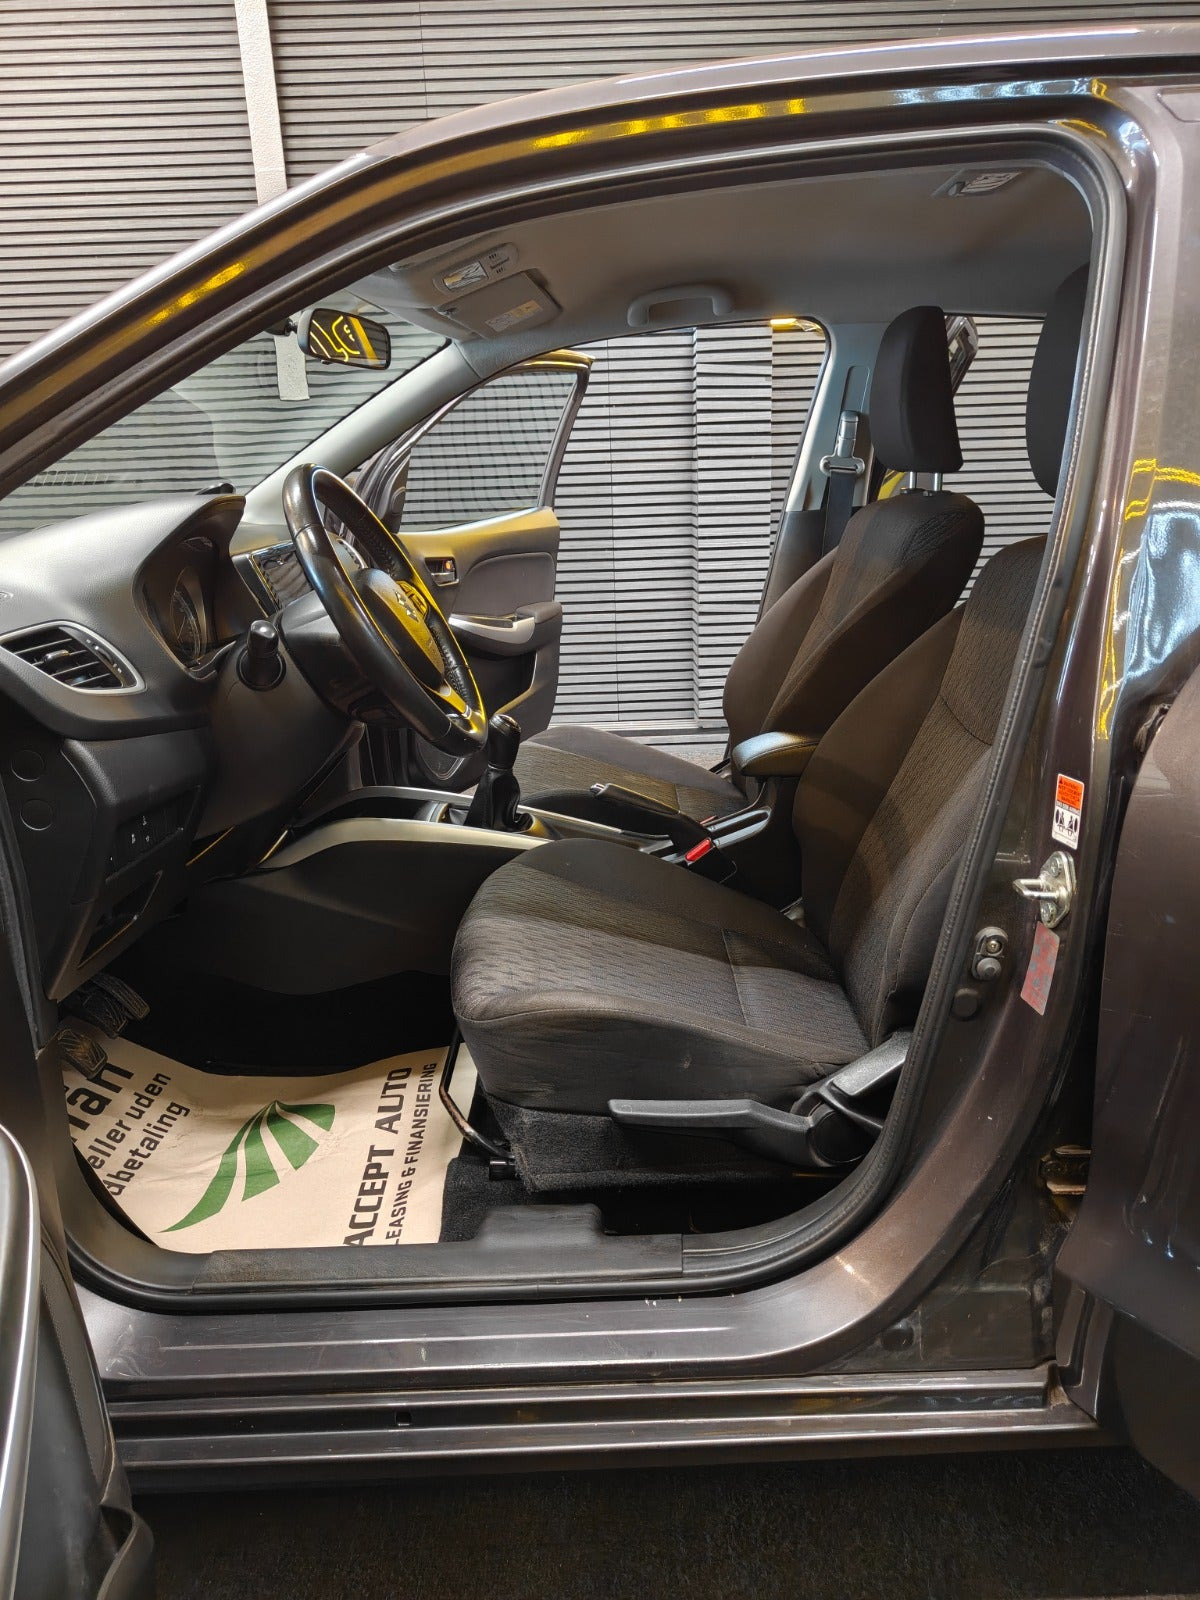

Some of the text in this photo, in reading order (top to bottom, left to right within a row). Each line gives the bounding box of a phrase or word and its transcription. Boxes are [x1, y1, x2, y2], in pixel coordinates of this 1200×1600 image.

[87, 1073, 171, 1169] eller uden
[103, 1101, 190, 1196] dbetaling
[343, 1067, 412, 1246] ACCEPT AUTO
[385, 1063, 437, 1245] EASING & FINANSIERING
